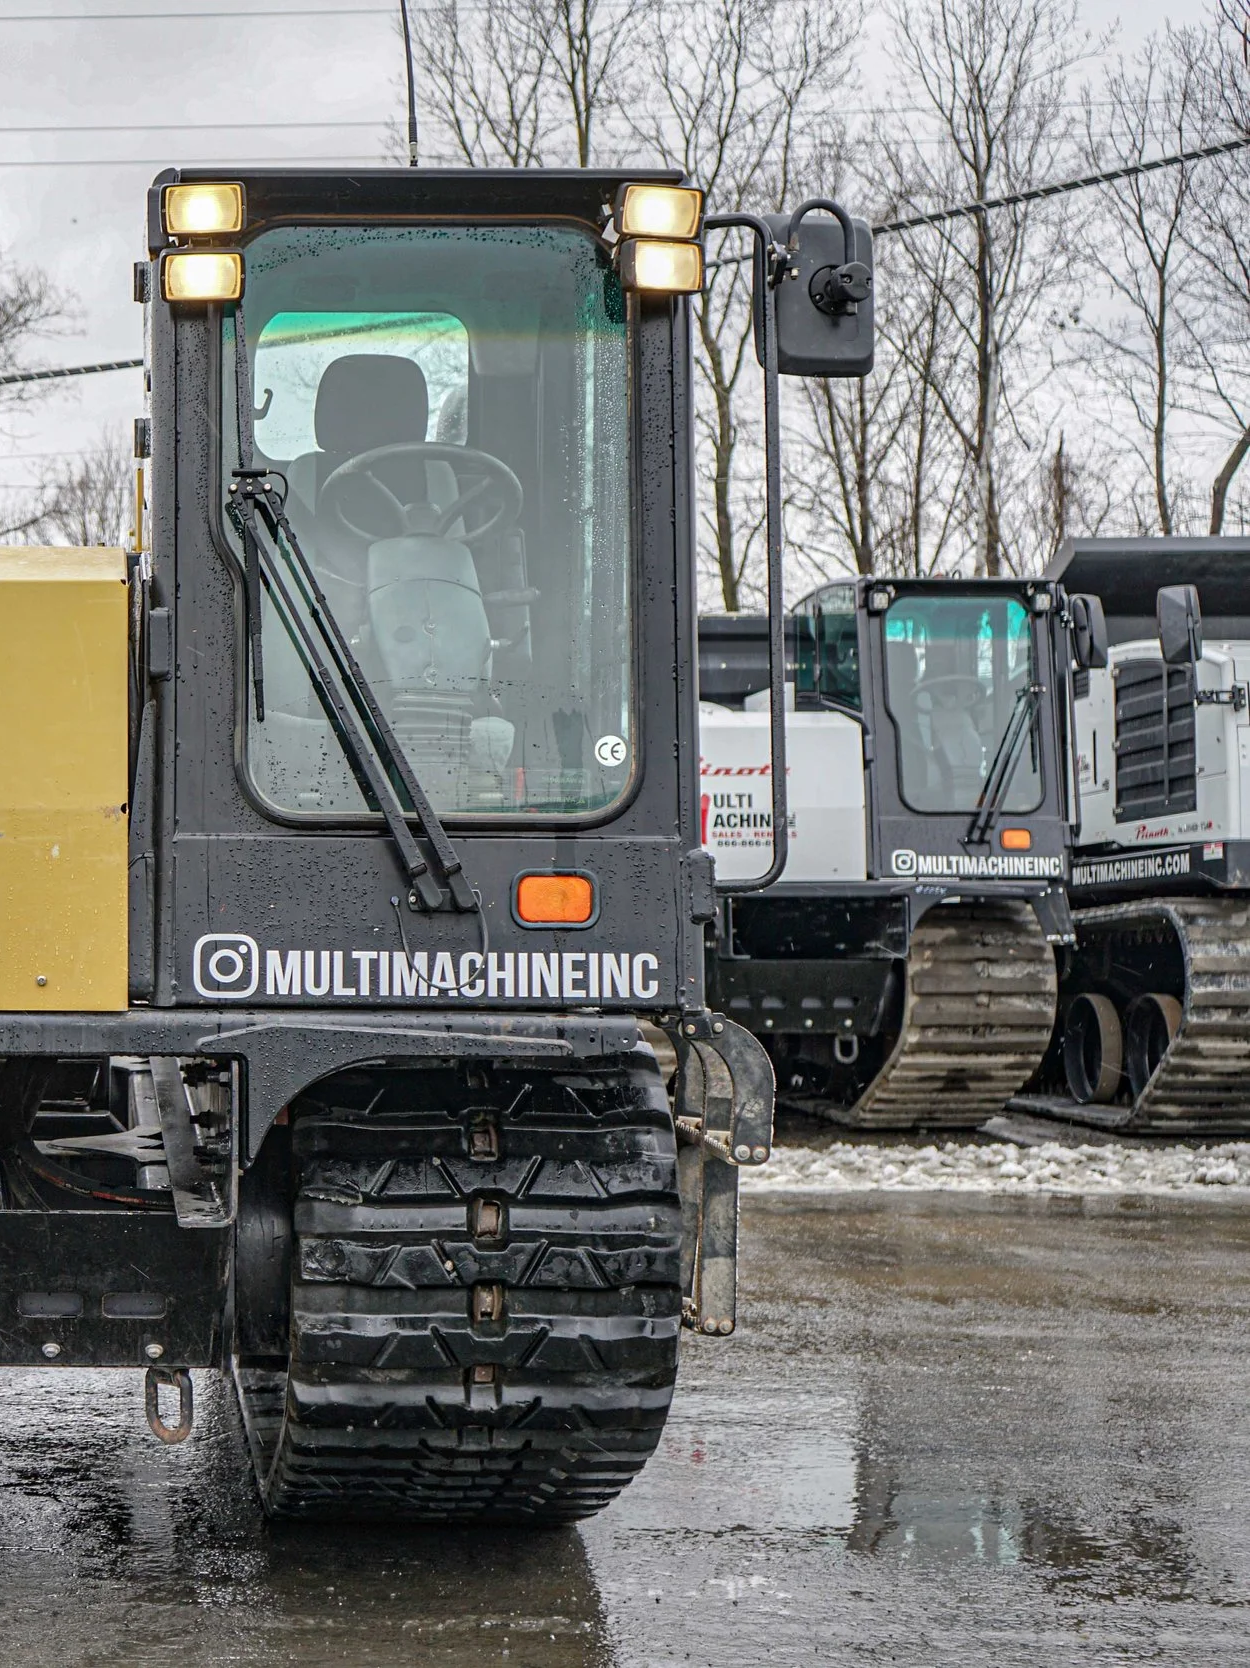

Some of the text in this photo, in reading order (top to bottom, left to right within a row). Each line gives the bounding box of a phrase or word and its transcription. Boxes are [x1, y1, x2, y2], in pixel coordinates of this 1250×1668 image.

[713, 814, 772, 828] ACHIN
[1072, 853, 1190, 887] MULTIMACHINEINC.COM
[265, 950, 658, 999] MULTIMACHINEINC
